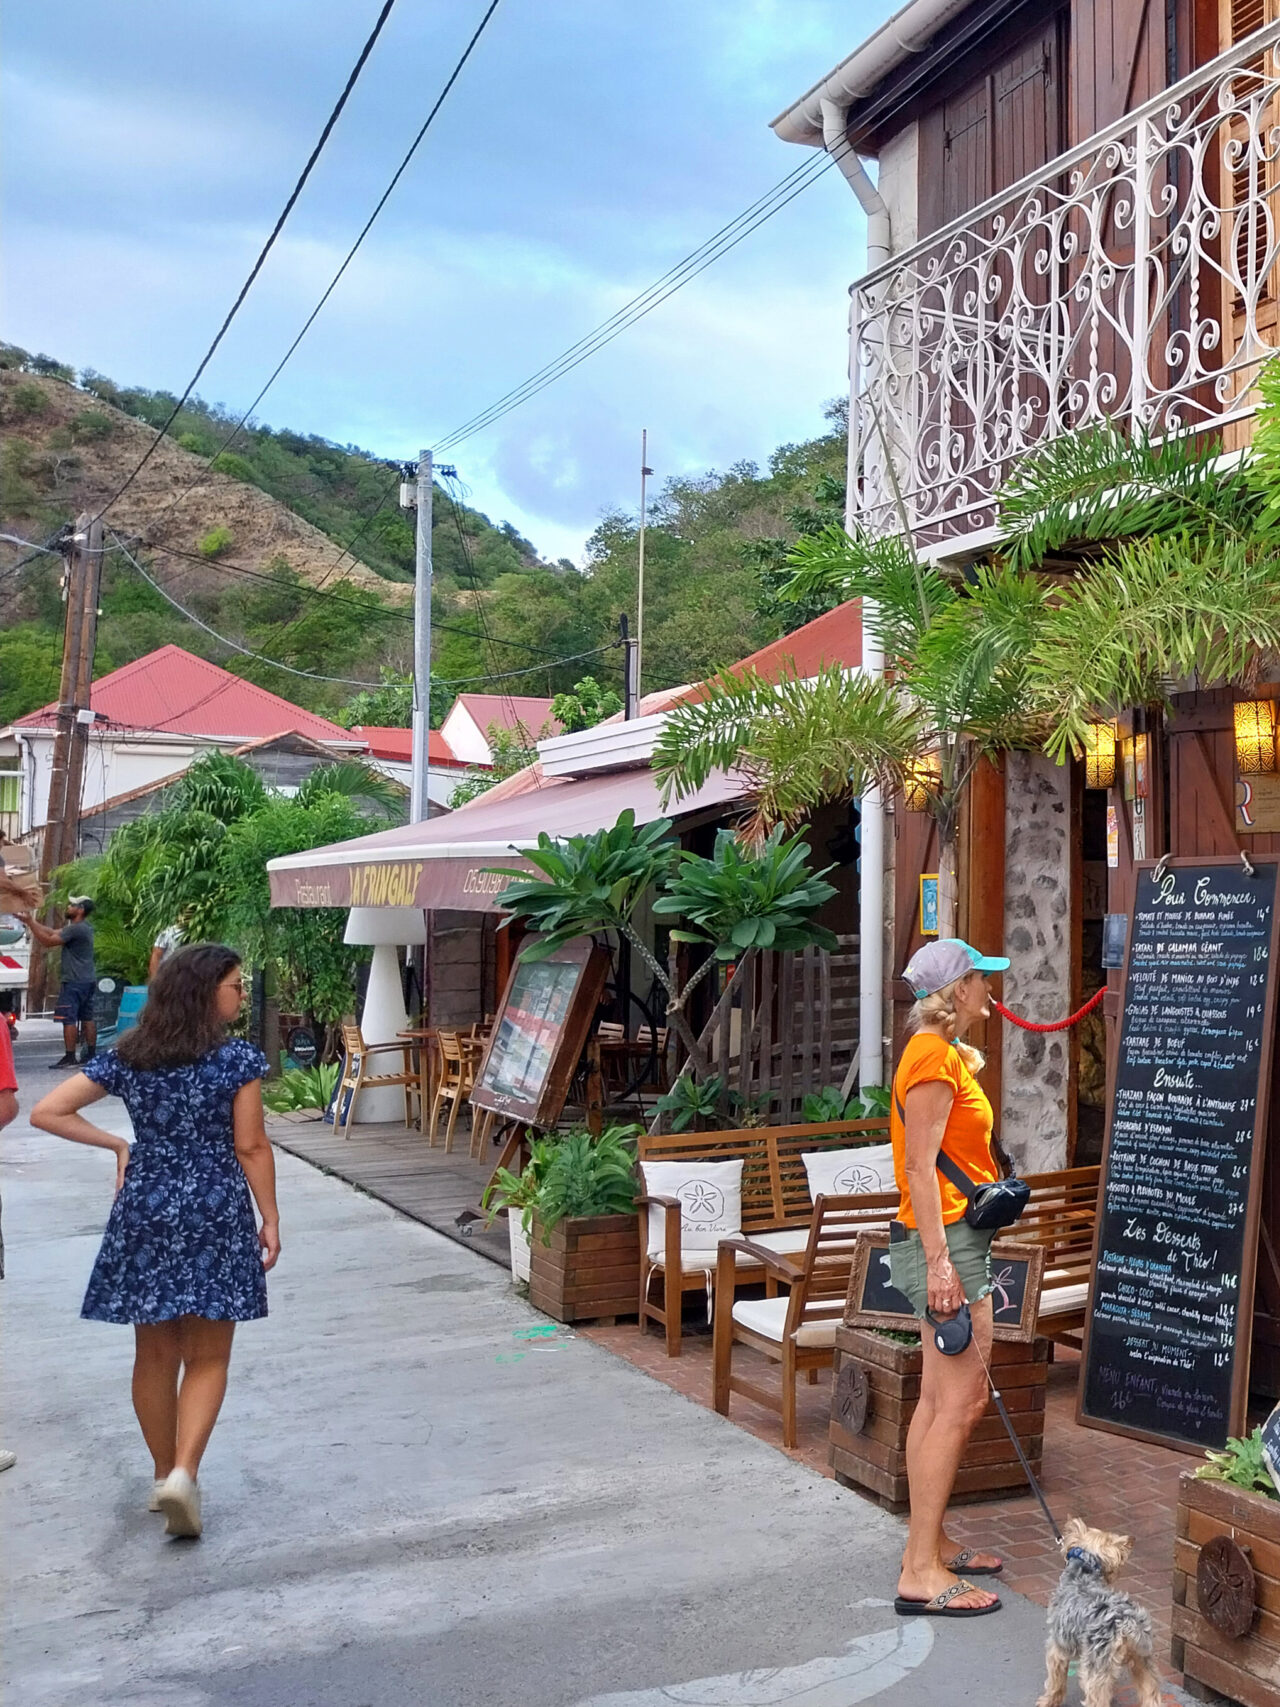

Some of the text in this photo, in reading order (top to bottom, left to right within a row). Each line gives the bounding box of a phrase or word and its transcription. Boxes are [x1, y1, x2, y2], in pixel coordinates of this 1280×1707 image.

[1152, 874, 1186, 905] Pour
[1122, 1217, 1202, 1251] Les Desserts
